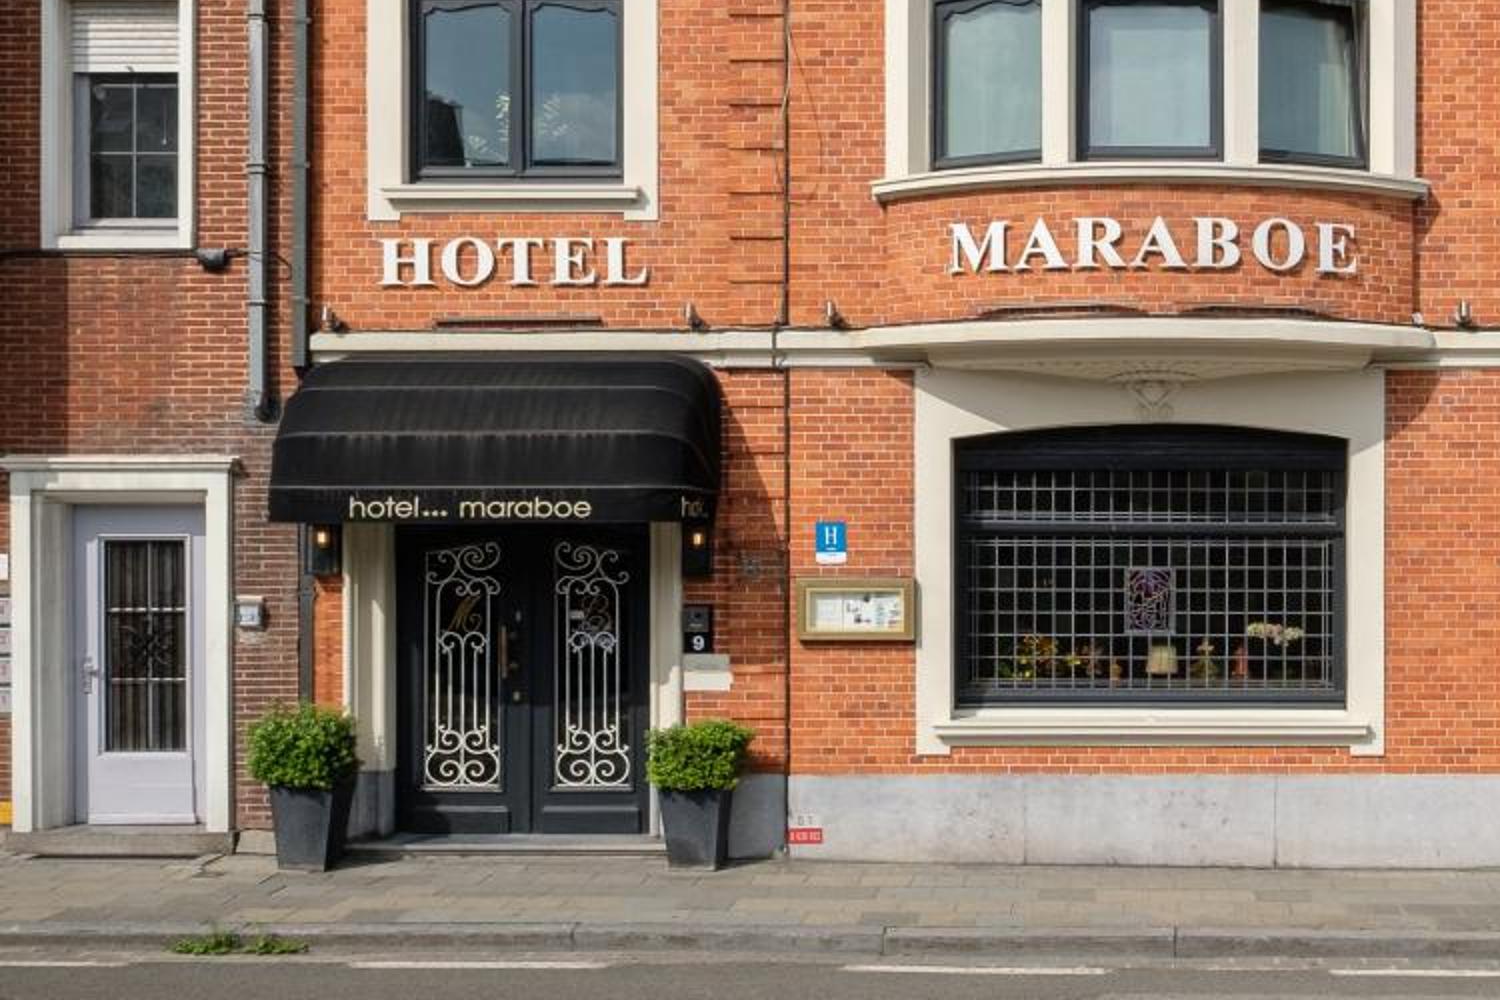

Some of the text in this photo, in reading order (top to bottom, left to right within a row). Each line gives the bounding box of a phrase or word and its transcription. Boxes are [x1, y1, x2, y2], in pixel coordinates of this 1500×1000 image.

[947, 215, 1358, 274] MARABOE
[379, 236, 648, 287] HOTEL
[459, 496, 593, 519] maraboe
[825, 525, 838, 545] H
[692, 635, 705, 651] 9
